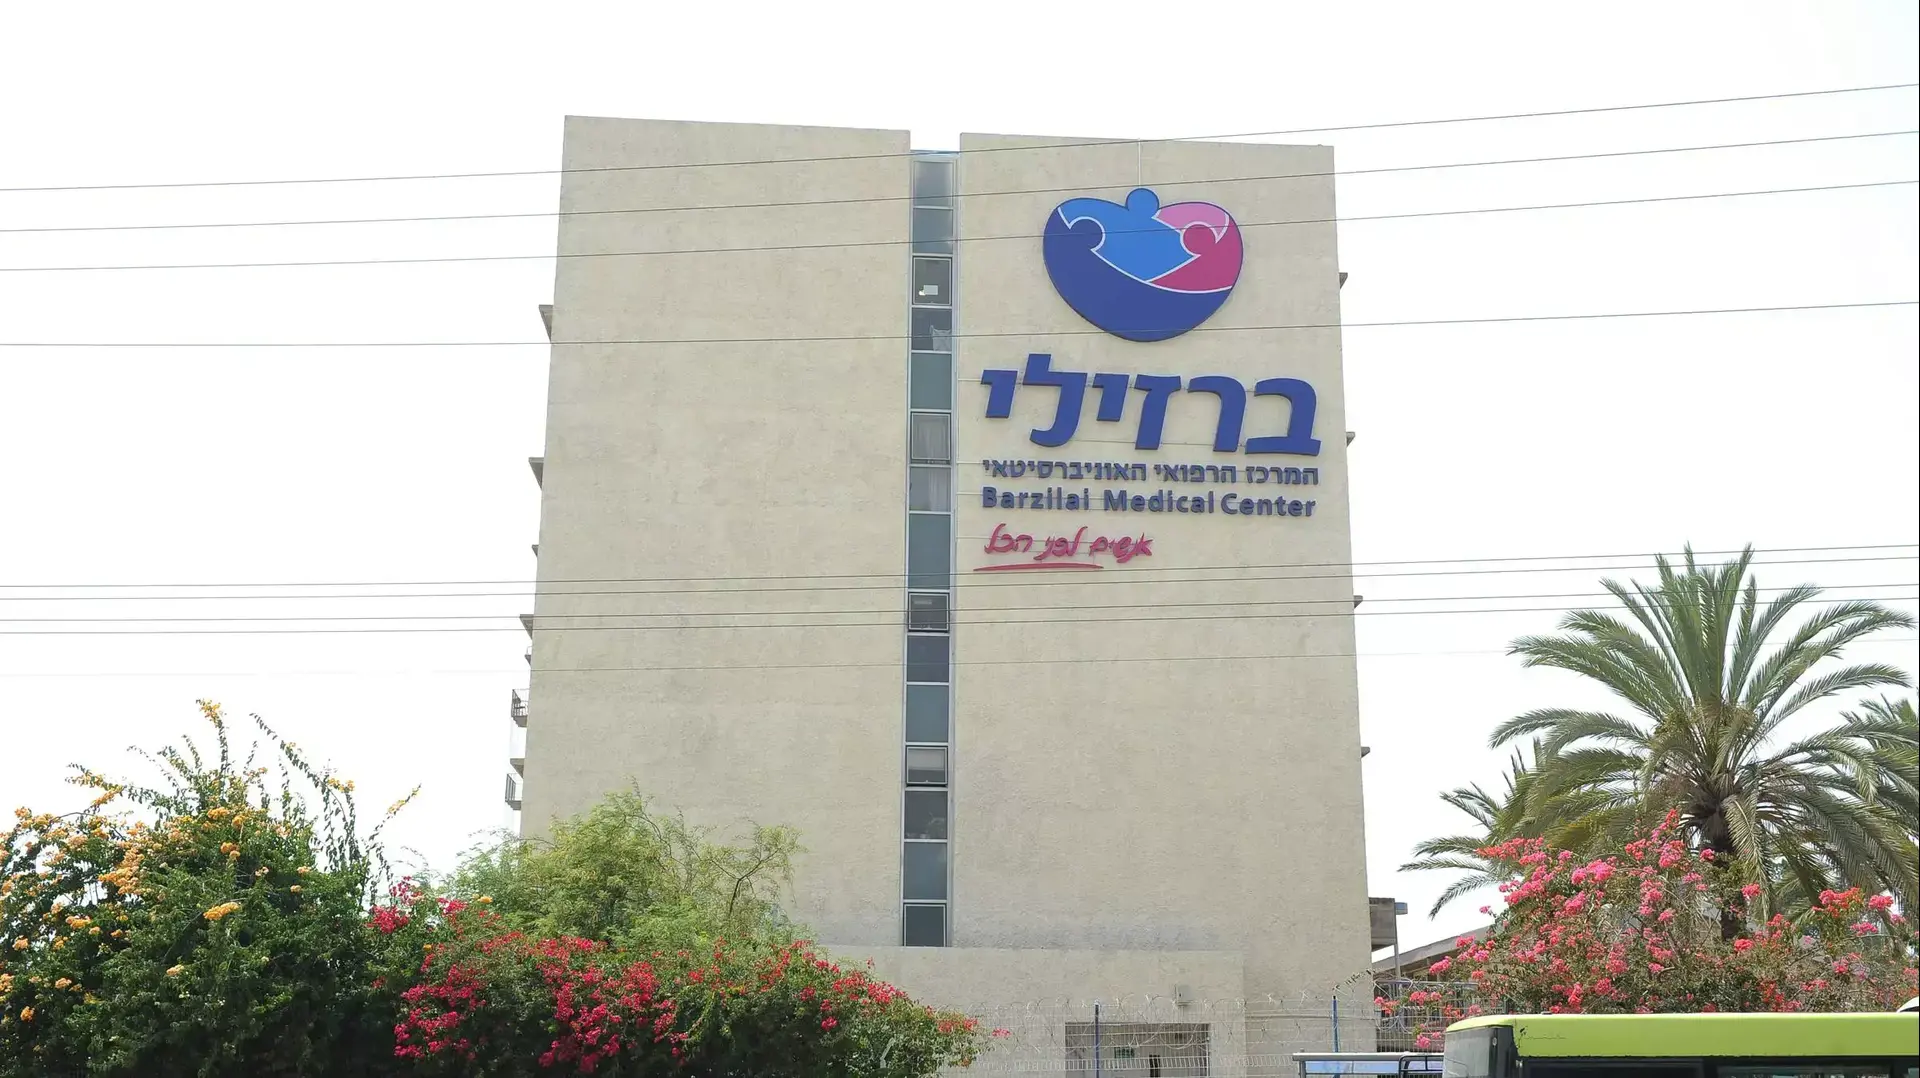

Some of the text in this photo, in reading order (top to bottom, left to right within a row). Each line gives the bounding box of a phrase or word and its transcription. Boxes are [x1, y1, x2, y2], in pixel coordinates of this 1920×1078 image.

[980, 353, 1322, 456] ברזילי
[982, 459, 1319, 486] המרכז הרפואי האוניברסיטאי
[982, 486, 1317, 517] Barzilai Medical Center
[983, 522, 1153, 564] אנשים לפני הכל
